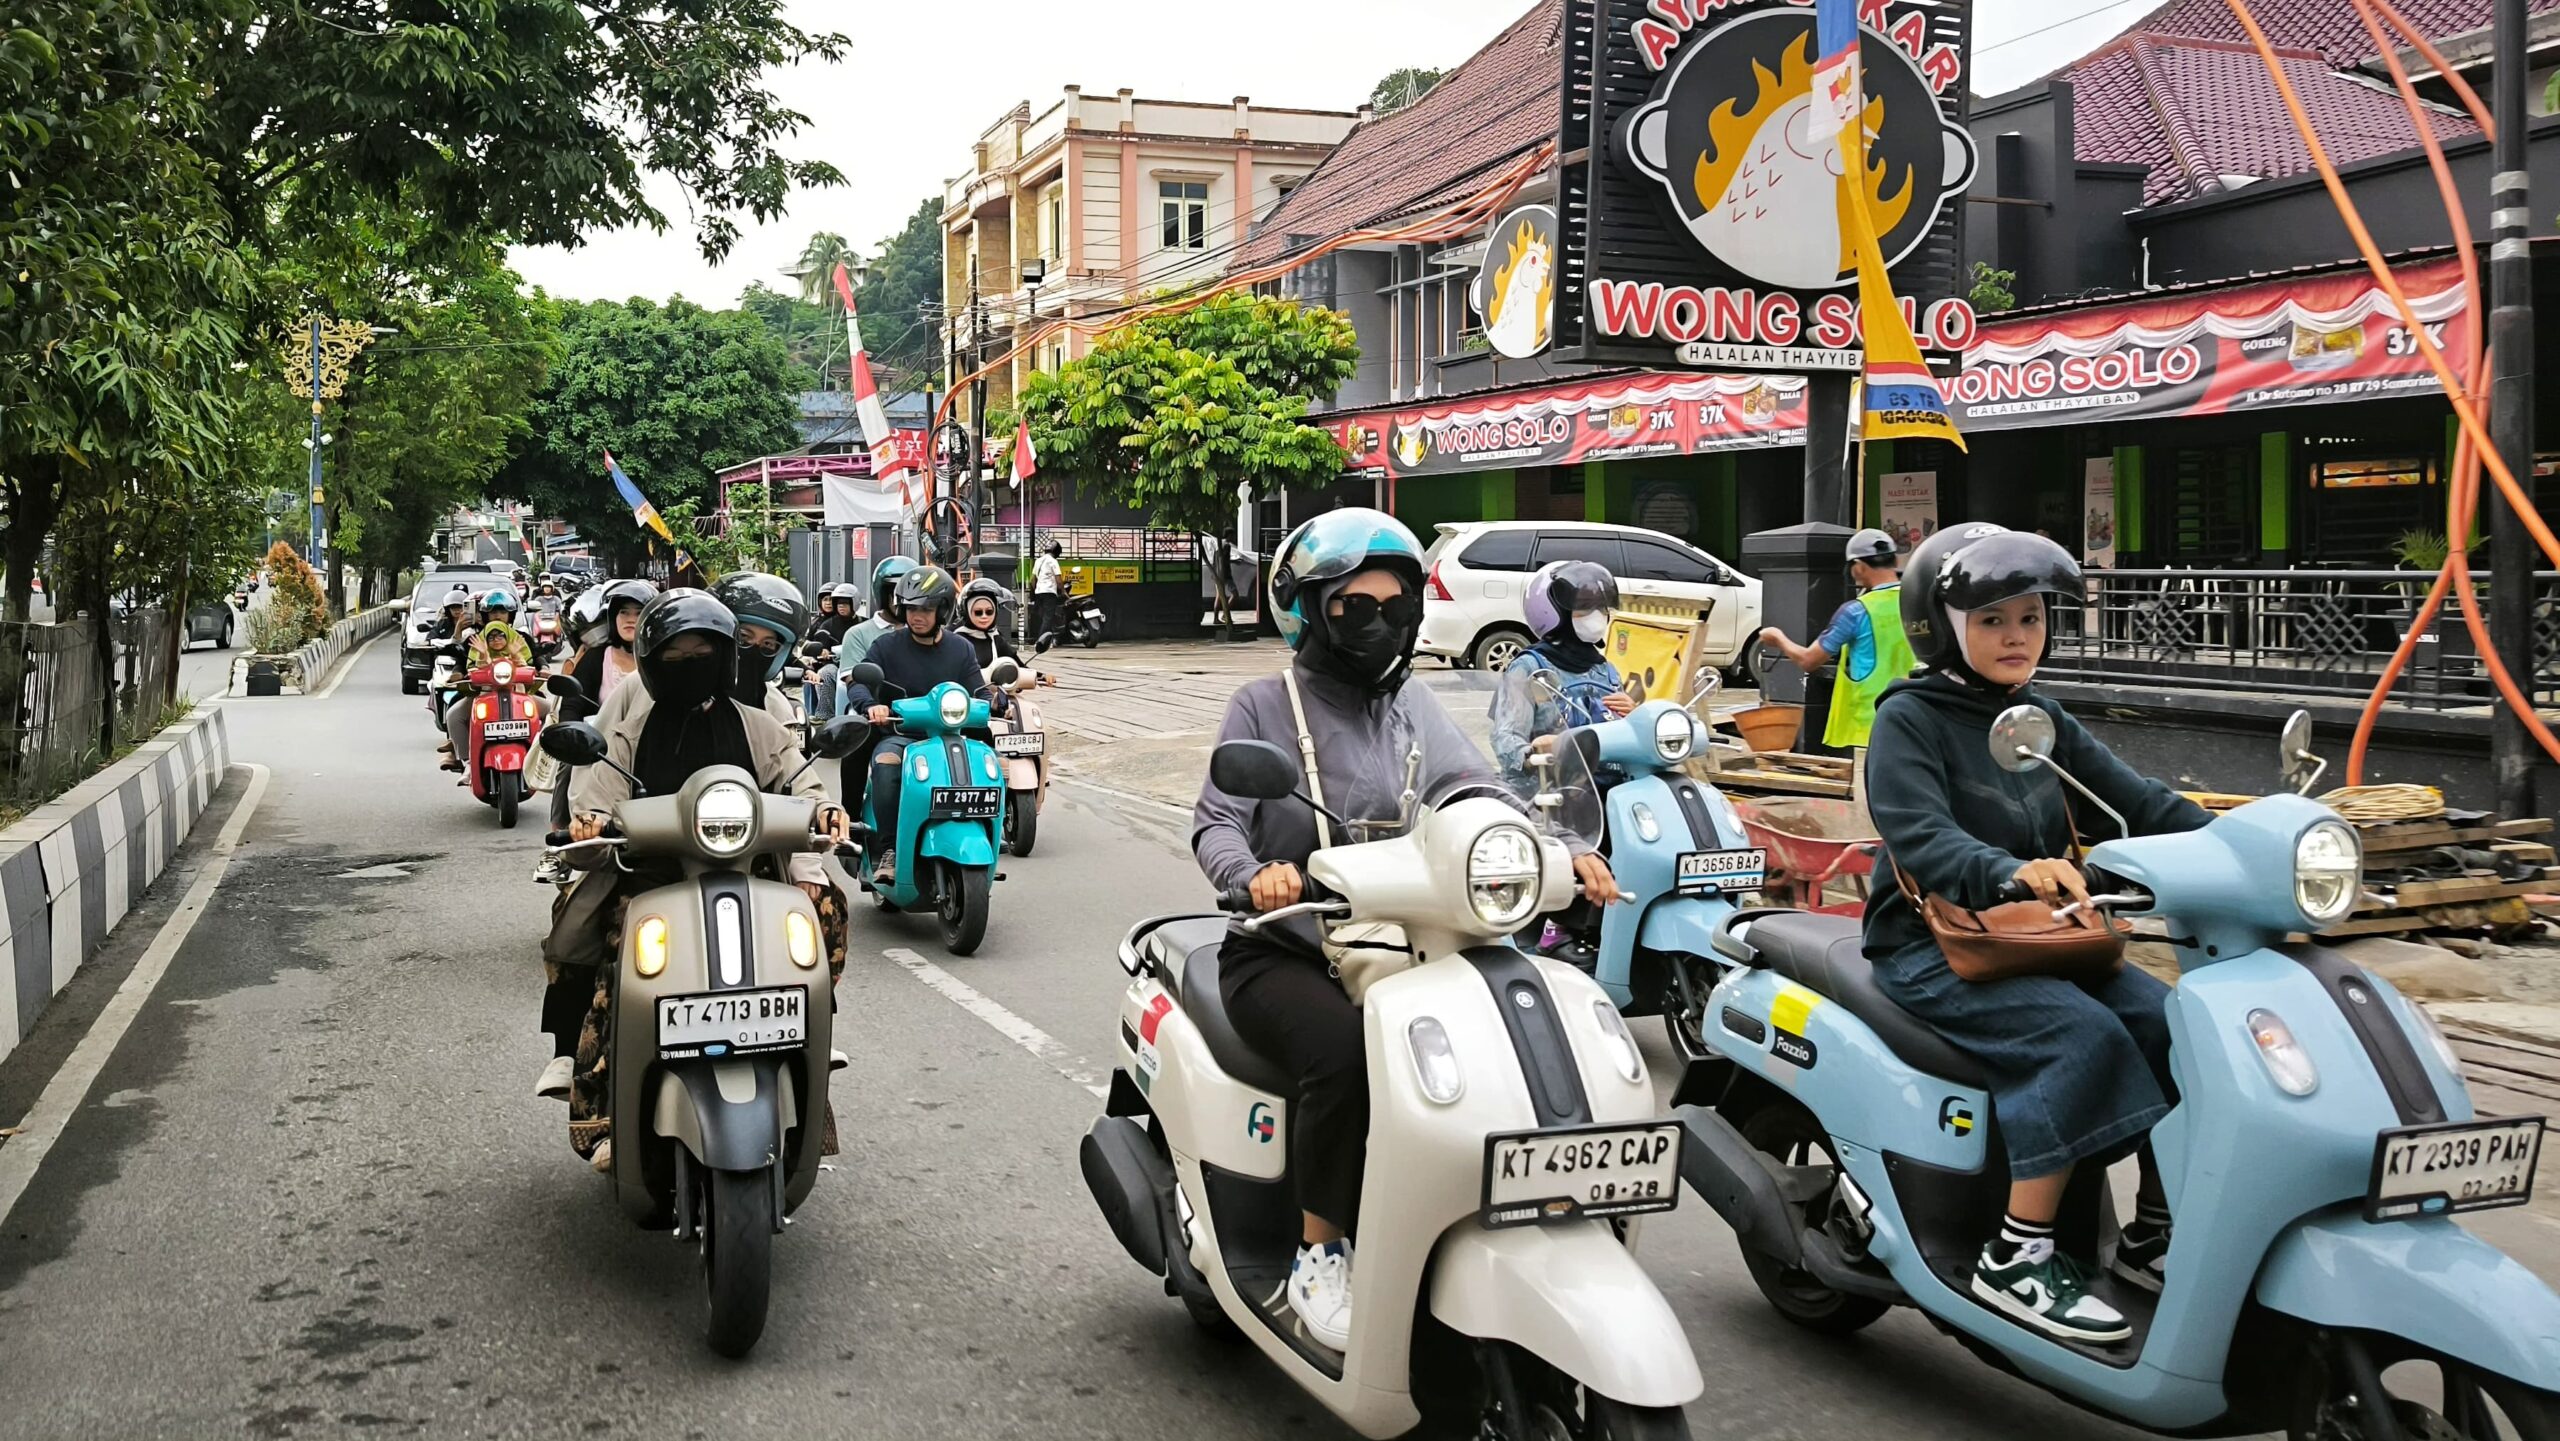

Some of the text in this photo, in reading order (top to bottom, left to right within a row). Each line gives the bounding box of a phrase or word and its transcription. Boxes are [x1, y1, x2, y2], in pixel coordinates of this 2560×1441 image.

[1598, 278, 1977, 352] WONG SLO
[2241, 336, 2287, 351] GORENG
[2386, 322, 2447, 355] 37K
[1688, 346, 1867, 368] HALALAN THAYYIB
[2060, 343, 2202, 395] SOLO
[2316, 387, 2332, 396] no
[2333, 383, 2347, 394] 28
[2365, 380, 2380, 392] 29
[2381, 374, 2443, 391] Samarind
[1699, 404, 1727, 425] 37K
[1969, 393, 2137, 417] HALALAN THAYYIBAN
[1649, 410, 1675, 431] 37K
[1436, 415, 1570, 455] WONG SOLO
[936, 791, 997, 803] KT 2977 AG
[1684, 855, 1761, 874] KT 3656 BAP
[667, 996, 799, 1027] KT 4713 BBH
[670, 1049, 700, 1059] YAMAHA
[1776, 1035, 1810, 1062] Fazzio
[1502, 1136, 1669, 1179] KT 4962 CAP
[2388, 1133, 2531, 1175] KT 2339 PAH
[1500, 1208, 1539, 1221] YAMAHA
